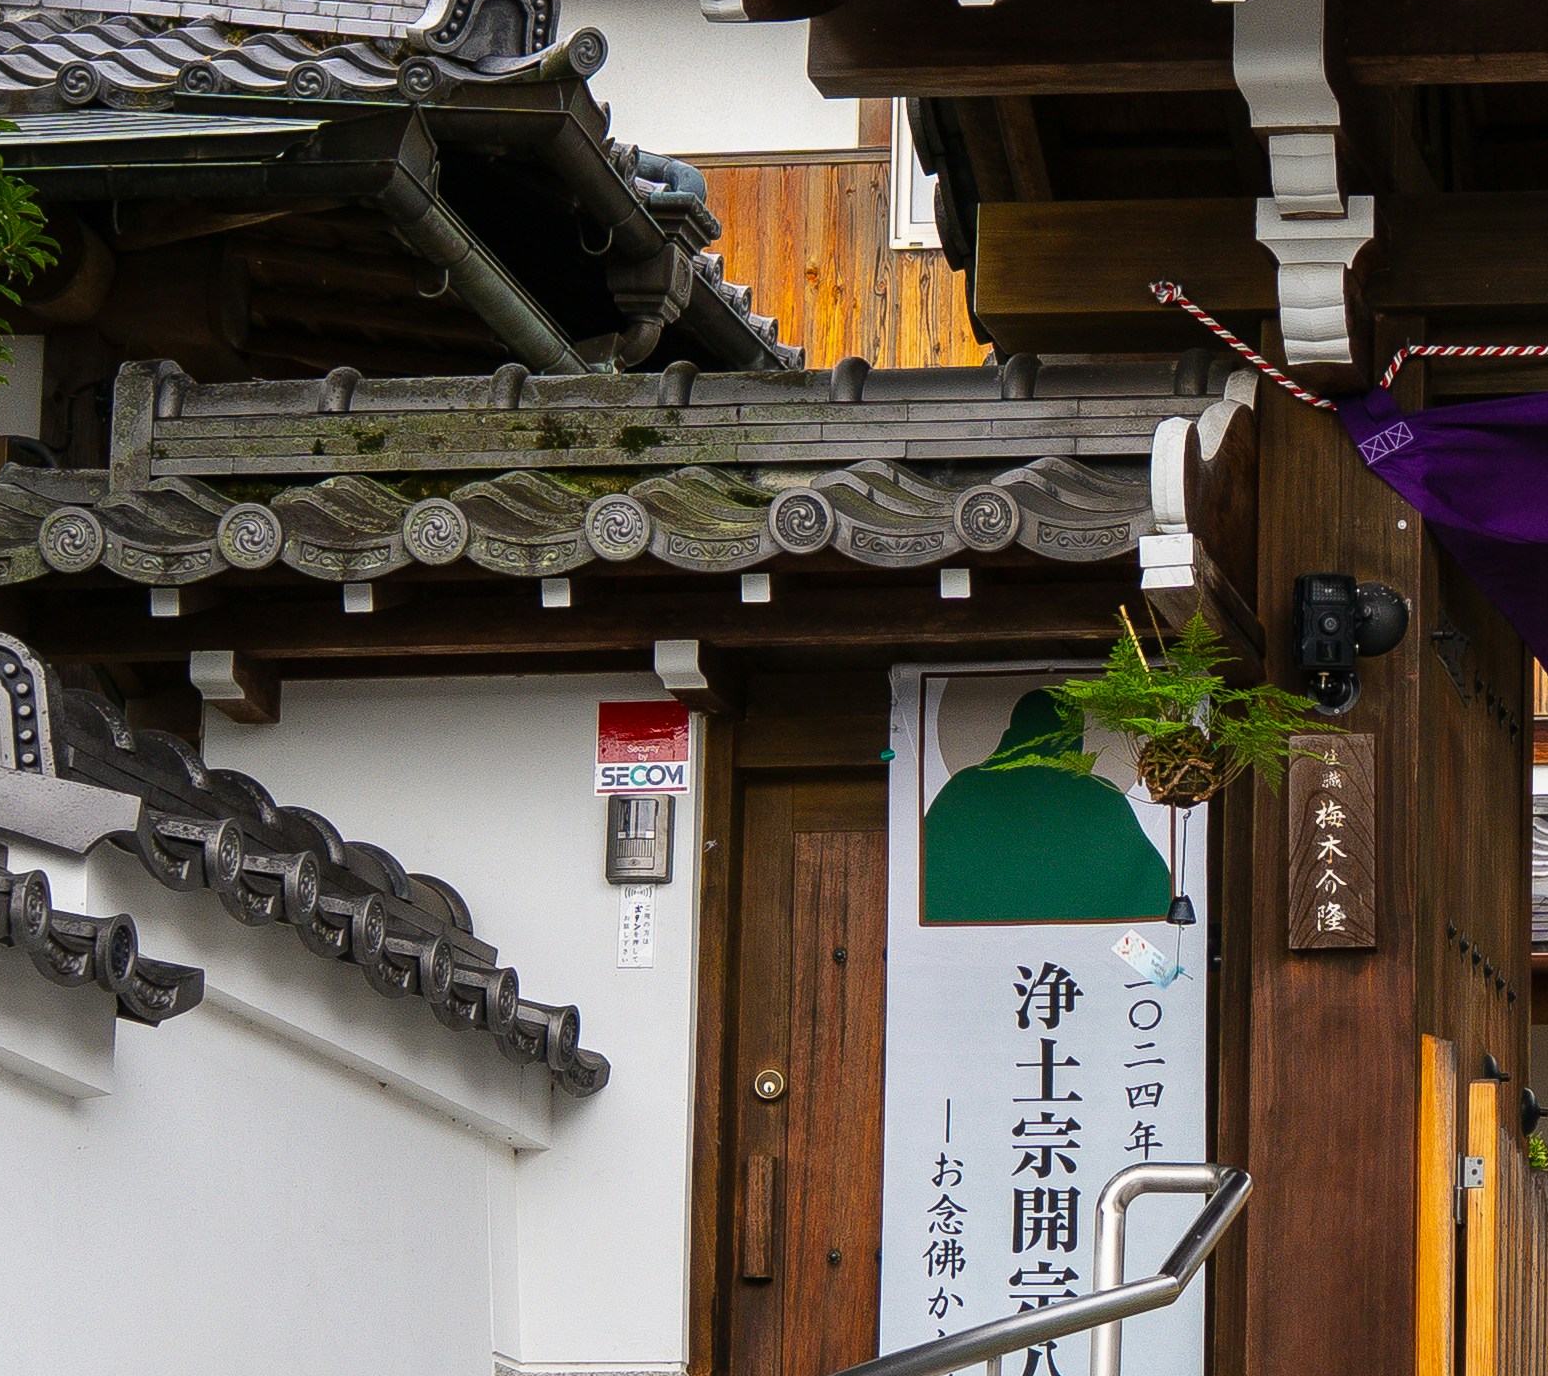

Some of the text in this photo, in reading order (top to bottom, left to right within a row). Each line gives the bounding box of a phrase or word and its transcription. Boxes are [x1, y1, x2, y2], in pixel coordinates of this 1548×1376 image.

[626, 744, 661, 754] Security
[637, 753, 649, 762] by
[600, 764, 684, 786] SECOM
